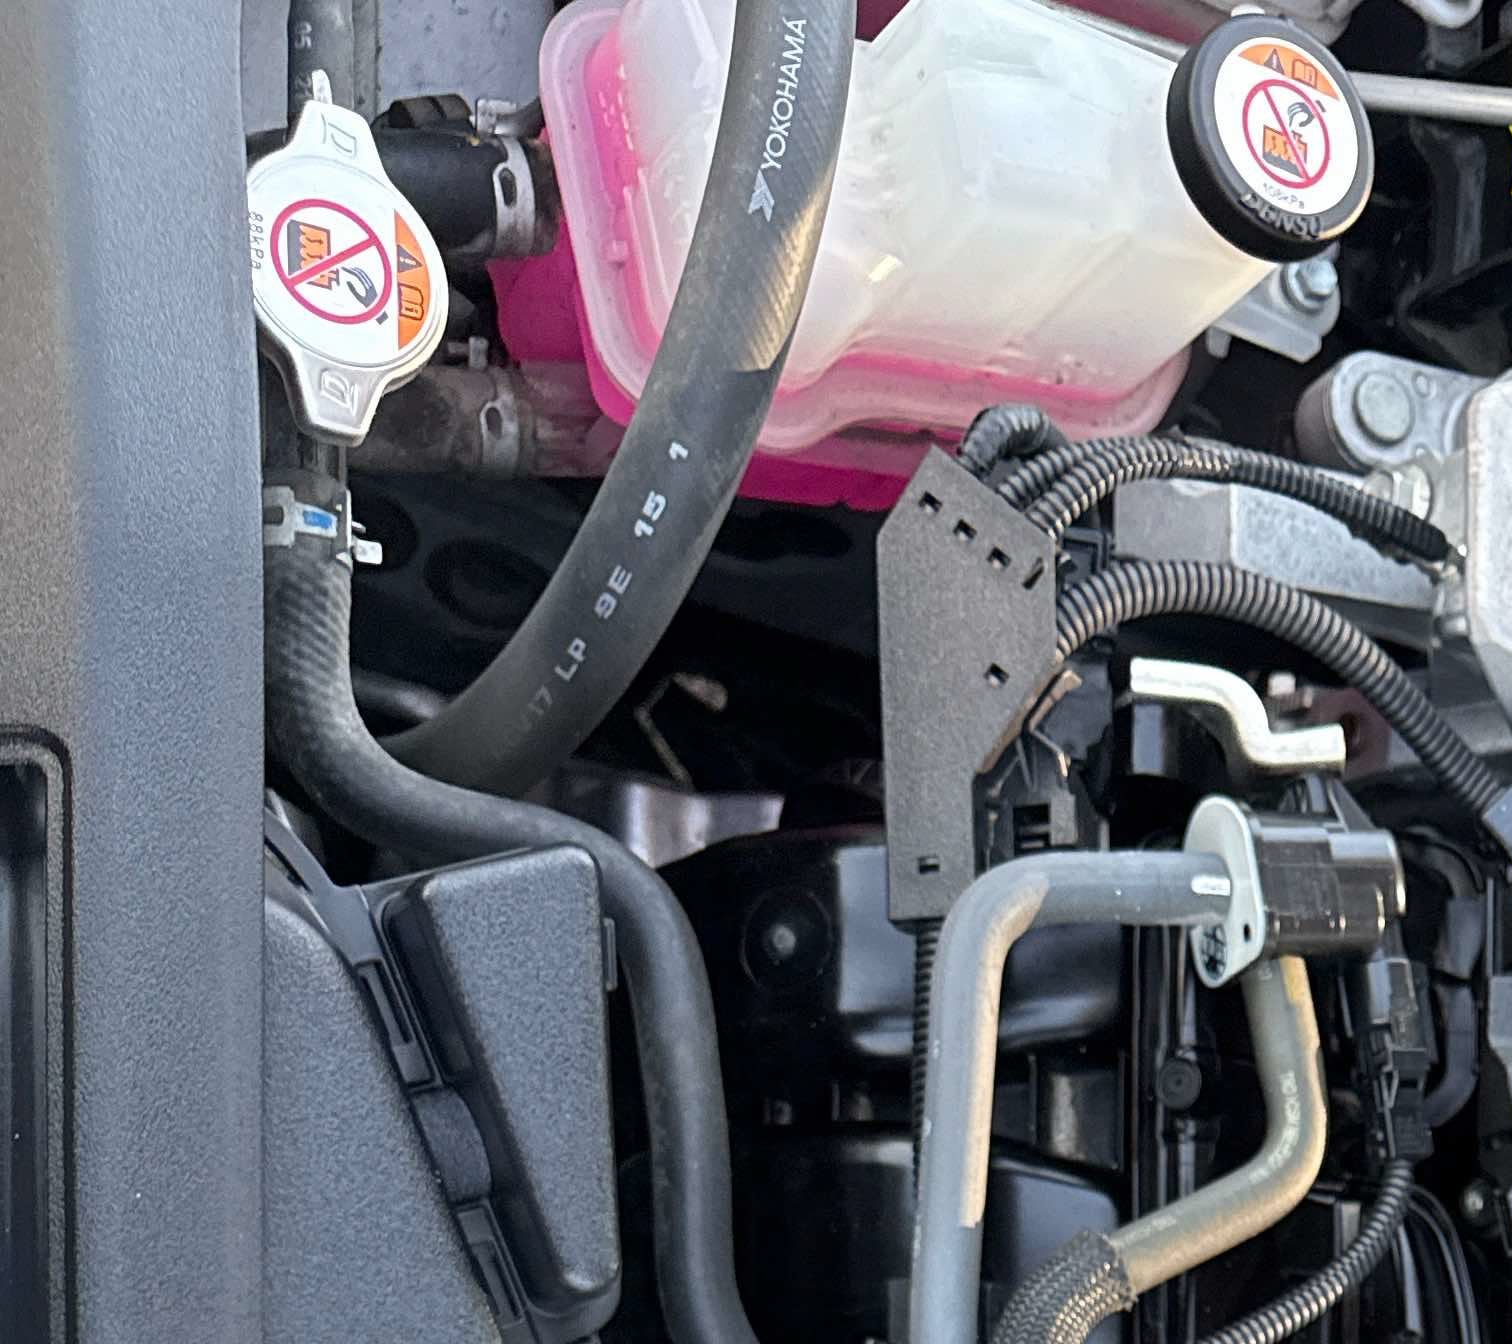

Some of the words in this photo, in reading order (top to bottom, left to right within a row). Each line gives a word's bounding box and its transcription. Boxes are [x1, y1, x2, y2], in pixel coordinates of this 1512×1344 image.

[760, 16, 807, 171] YOKOHAMA
[248, 210, 265, 271] 88kPa
[554, 637, 588, 682] LP
[633, 489, 668, 538] 15
[668, 440, 689, 461] 1
